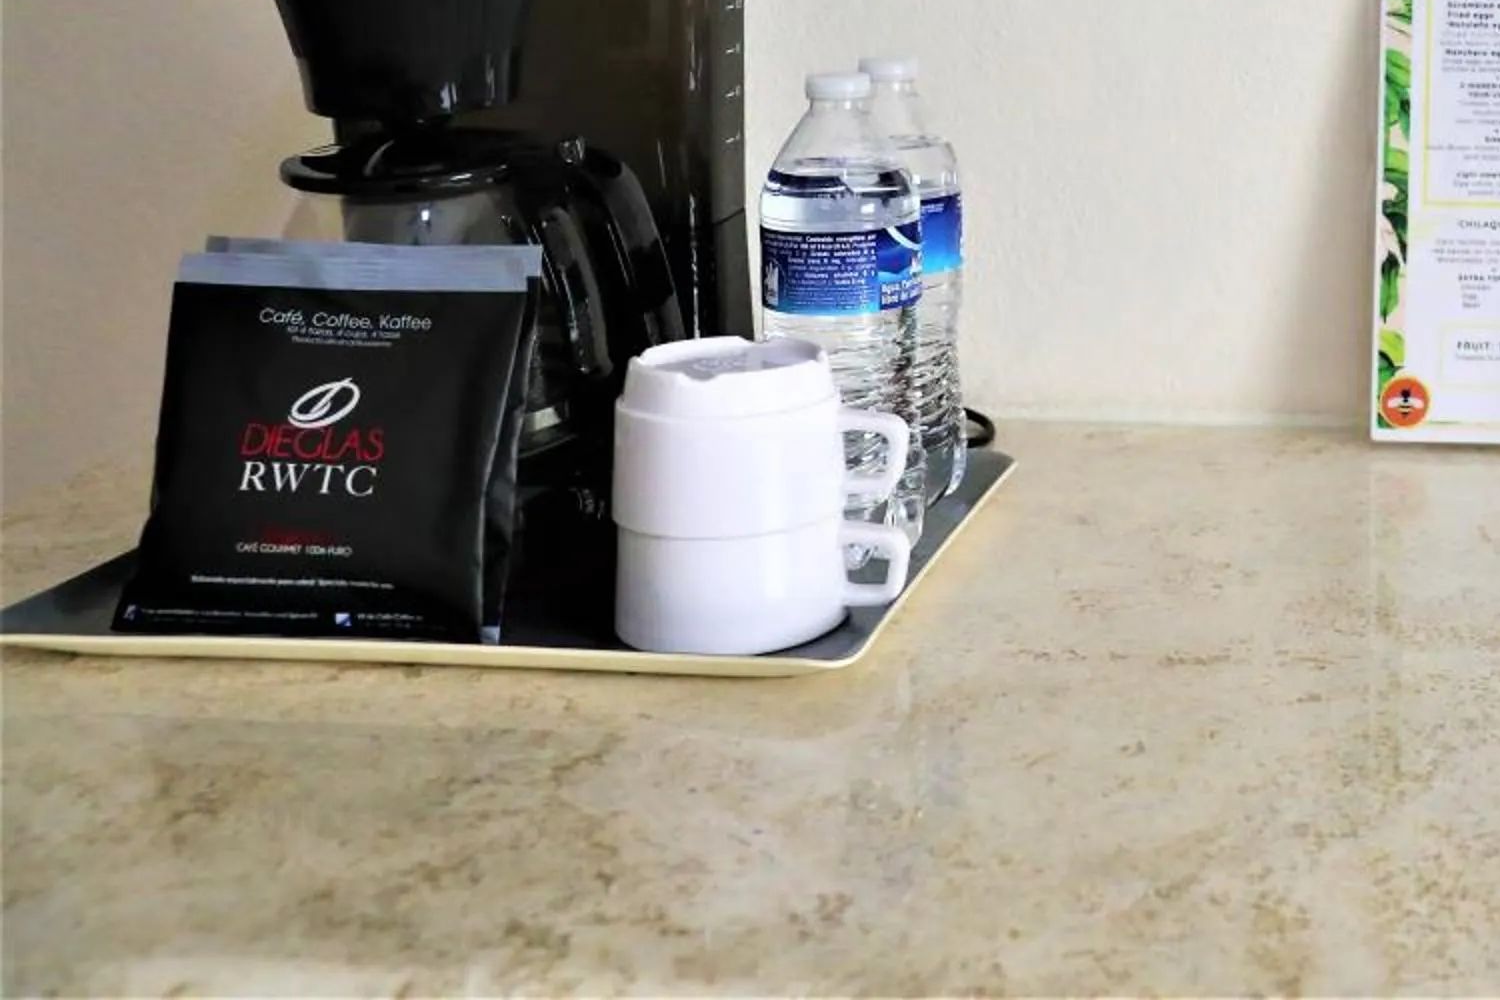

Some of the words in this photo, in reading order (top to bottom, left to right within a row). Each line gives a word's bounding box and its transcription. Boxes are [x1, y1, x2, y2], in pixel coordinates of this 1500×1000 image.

[1472, 12, 1495, 21] eggs
[258, 307, 306, 326] Café,
[378, 314, 433, 332] Kaffee
[239, 460, 378, 497] RWTC
